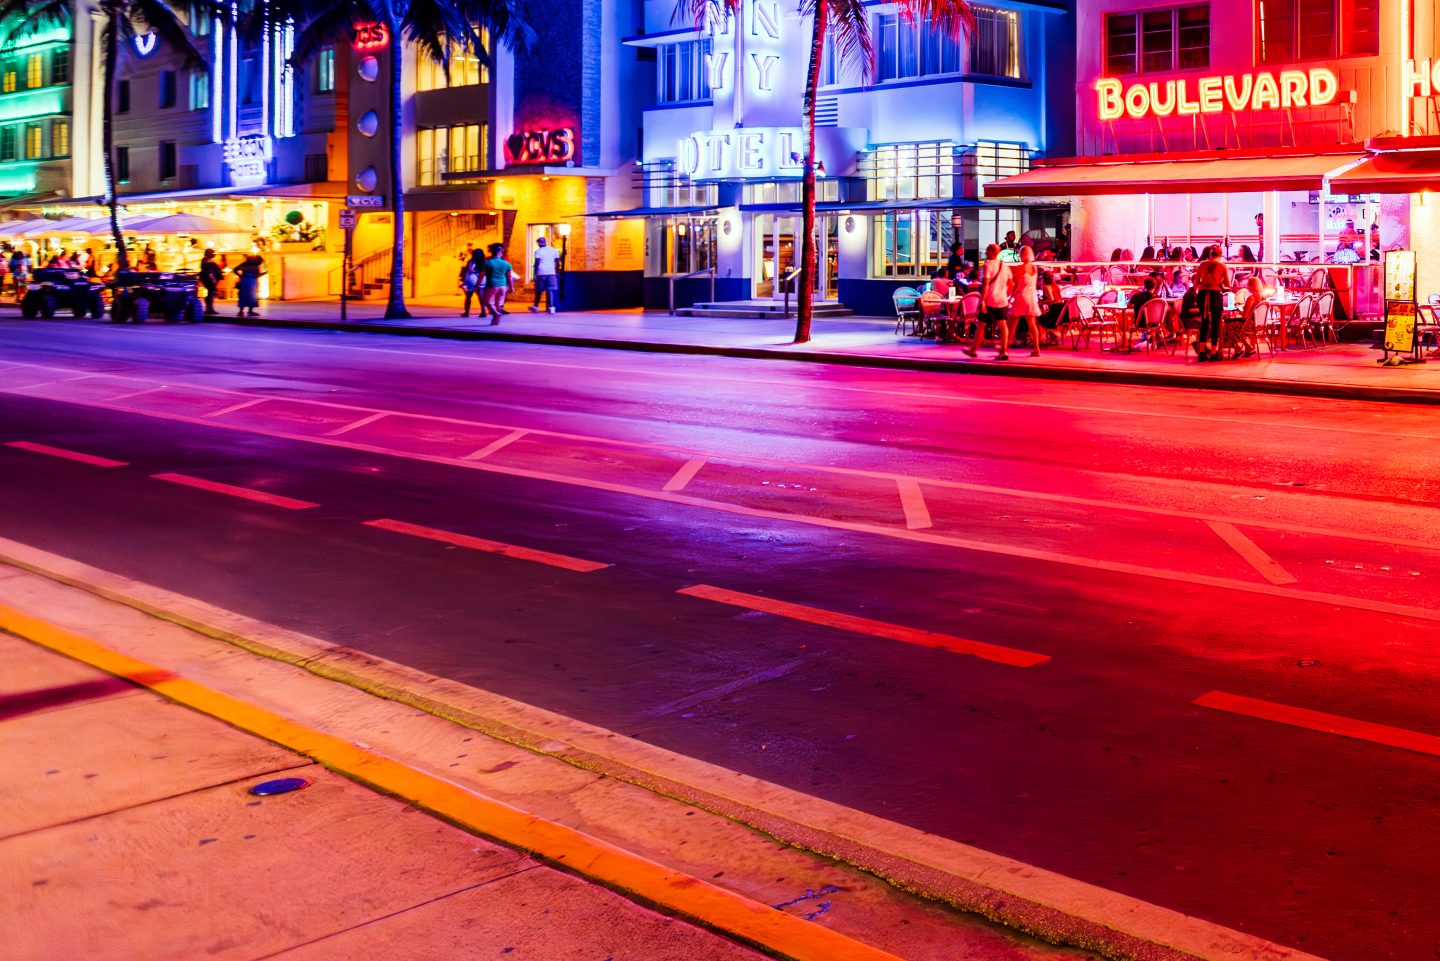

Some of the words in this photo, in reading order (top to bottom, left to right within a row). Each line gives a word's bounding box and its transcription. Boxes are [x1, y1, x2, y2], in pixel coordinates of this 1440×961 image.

[1097, 68, 1338, 121] BOULEVARD
[525, 127, 574, 161] CVS
[360, 196, 384, 206] CVS
